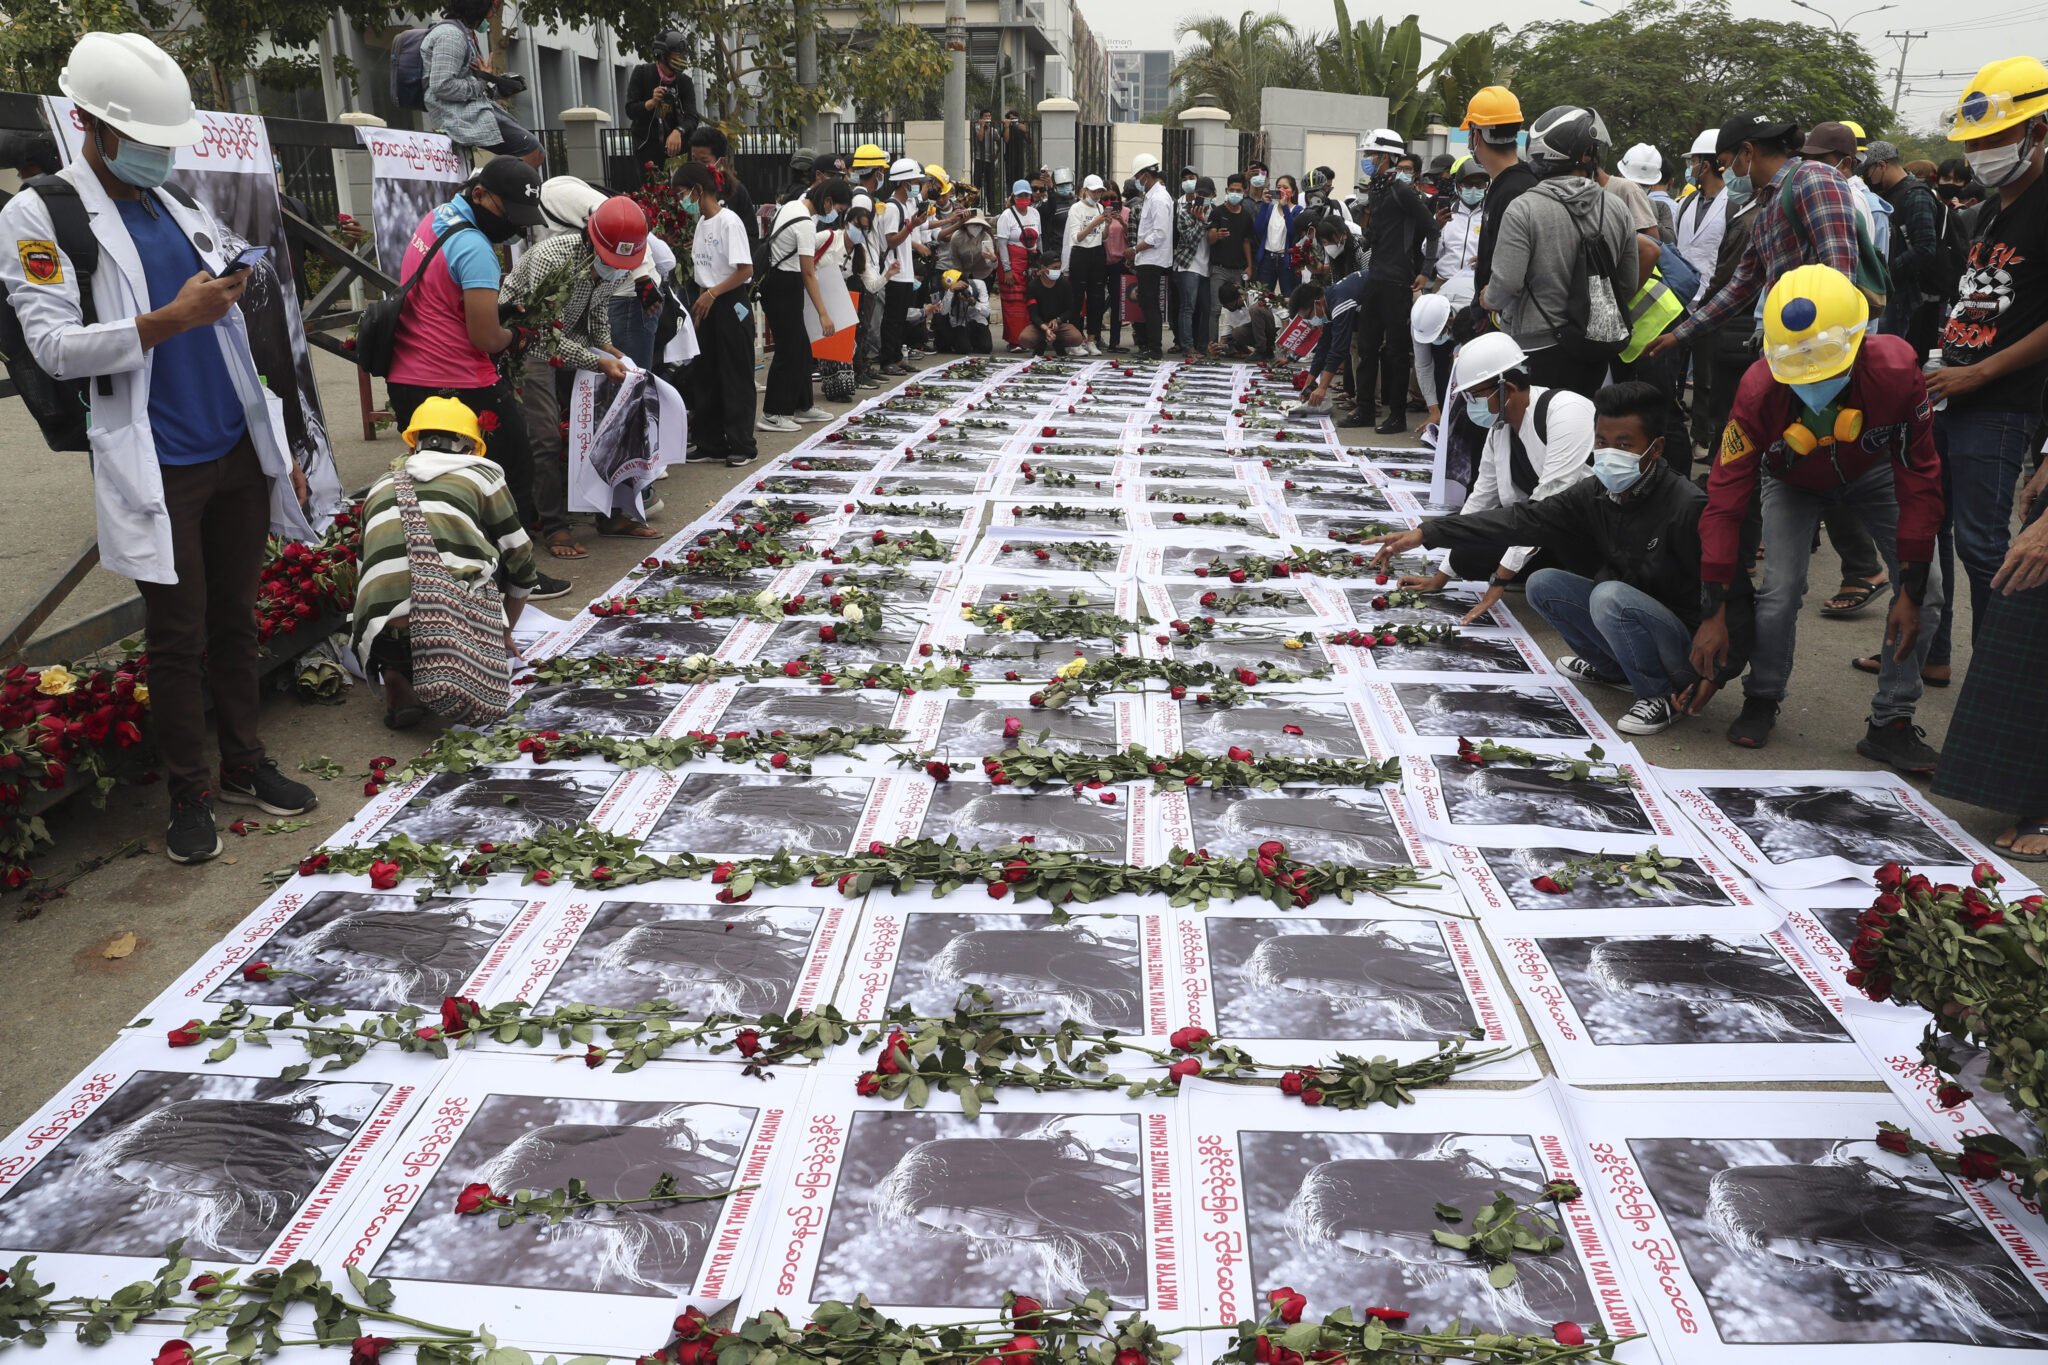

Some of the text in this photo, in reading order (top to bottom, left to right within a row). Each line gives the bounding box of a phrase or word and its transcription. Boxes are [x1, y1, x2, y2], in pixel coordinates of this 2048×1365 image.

[1282, 328, 1302, 349] END
[1290, 327, 1312, 351] DICTATO
[472, 973, 490, 987] MYA
[482, 945, 511, 972] THWATE
[816, 930, 836, 954] THWATE
[185, 946, 253, 998] အာဇာနည်
[800, 982, 817, 996] MYA
[805, 954, 828, 981] THWATE
[1146, 915, 1166, 1036] MARTYR MYA THWATE THWATE KHAING
[1444, 920, 1504, 1041] MARTYR MYA THWATE THWATE KHAING
[1804, 970, 1832, 996] THWATE
[1530, 985, 1576, 1041] အာဇာနည်
[267, 1086, 415, 1266] MARTYR MYA THWATE THWATE KHAING
[1540, 1135, 1569, 1169] KHAING
[342, 1097, 468, 1269] အာဇာနည် မမြသွဲ့သွဲ့ခိုင်
[701, 1253, 733, 1299] MARTYR
[717, 1228, 742, 1251] MYA
[742, 1145, 772, 1182] THWATE
[758, 1109, 784, 1142] KHAING
[777, 1115, 842, 1296] အာဇာနည် မမြသွဲ့သွဲ့ခိုင်
[1149, 1113, 1178, 1310] MARTYR MYA THWATE THWATE KHAING
[1198, 1135, 1242, 1326] အာဇာနည် မမြသွဲ့သွဲ့ခိုင်
[1571, 1214, 1605, 1258] THWATE
[1590, 1143, 1698, 1334] အာဇာနည် မမြသွဲ့သွဲ့ခိုင်
[1994, 1224, 2045, 1268] THWATE
[1591, 1260, 1616, 1285] MYA
[1600, 1288, 1637, 1337] MARTYR
